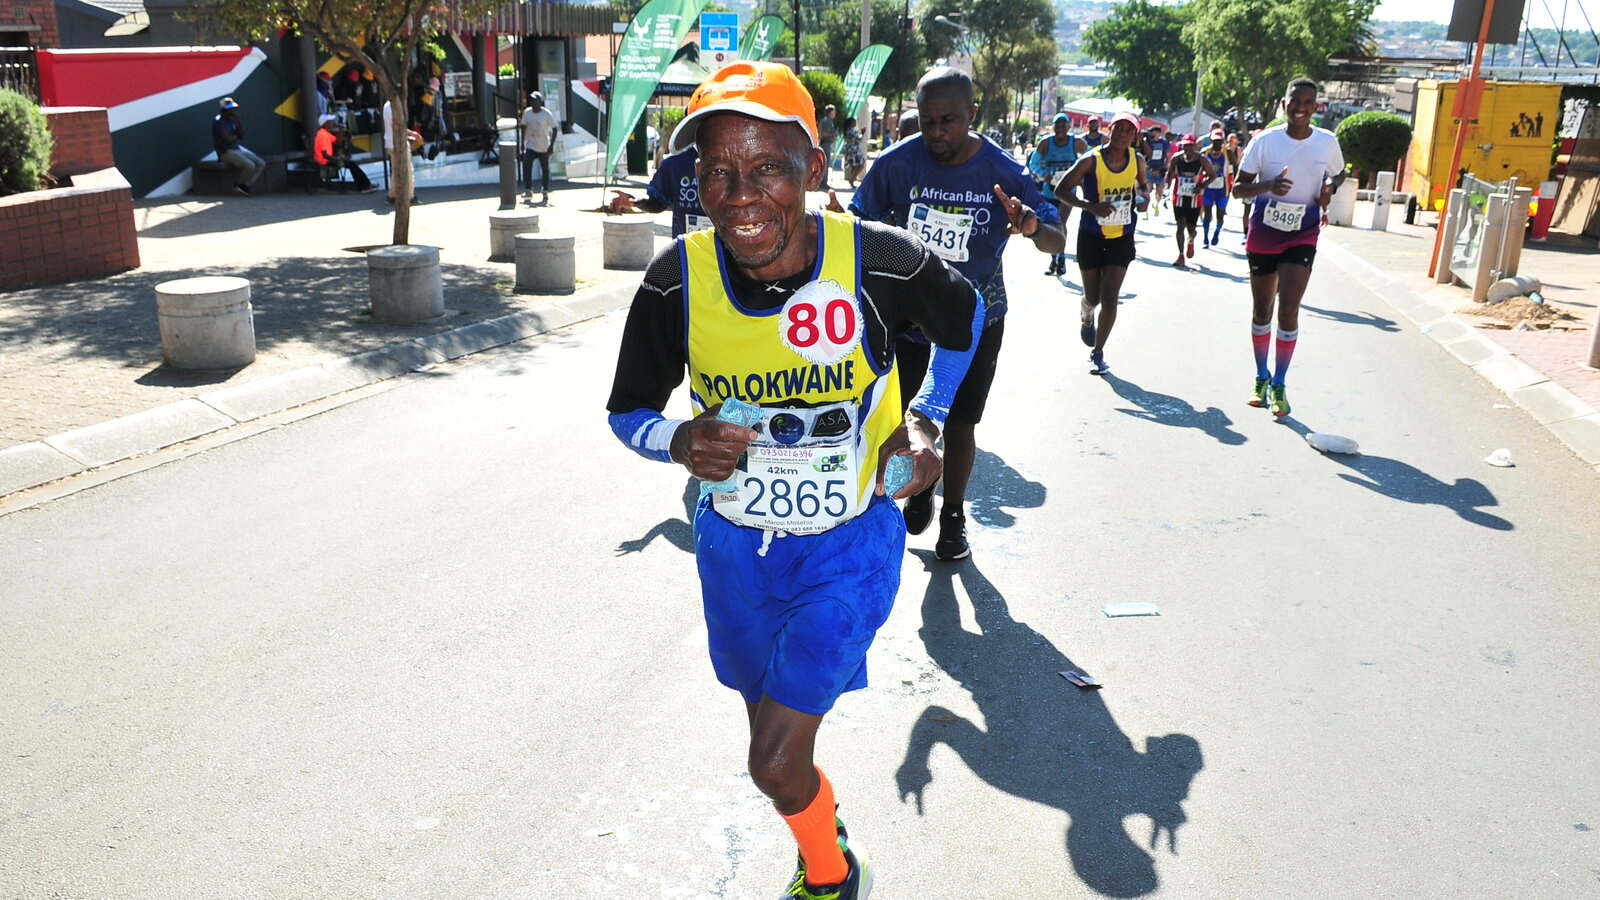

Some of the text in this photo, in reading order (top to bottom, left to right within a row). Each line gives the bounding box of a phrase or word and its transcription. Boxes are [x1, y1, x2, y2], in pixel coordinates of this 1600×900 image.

[620, 54, 661, 63] VOLUNTEERS
[627, 63, 656, 71] SUPPORT
[679, 188, 697, 201] SO
[921, 187, 993, 204] African Bank
[1104, 187, 1132, 195] SAPS
[911, 222, 966, 251] G 5431
[787, 299, 856, 348] 80
[700, 360, 854, 402] POLOKWANE
[818, 411, 848, 428] ASA
[767, 466, 799, 475] 42km
[744, 477, 848, 518] 2865
